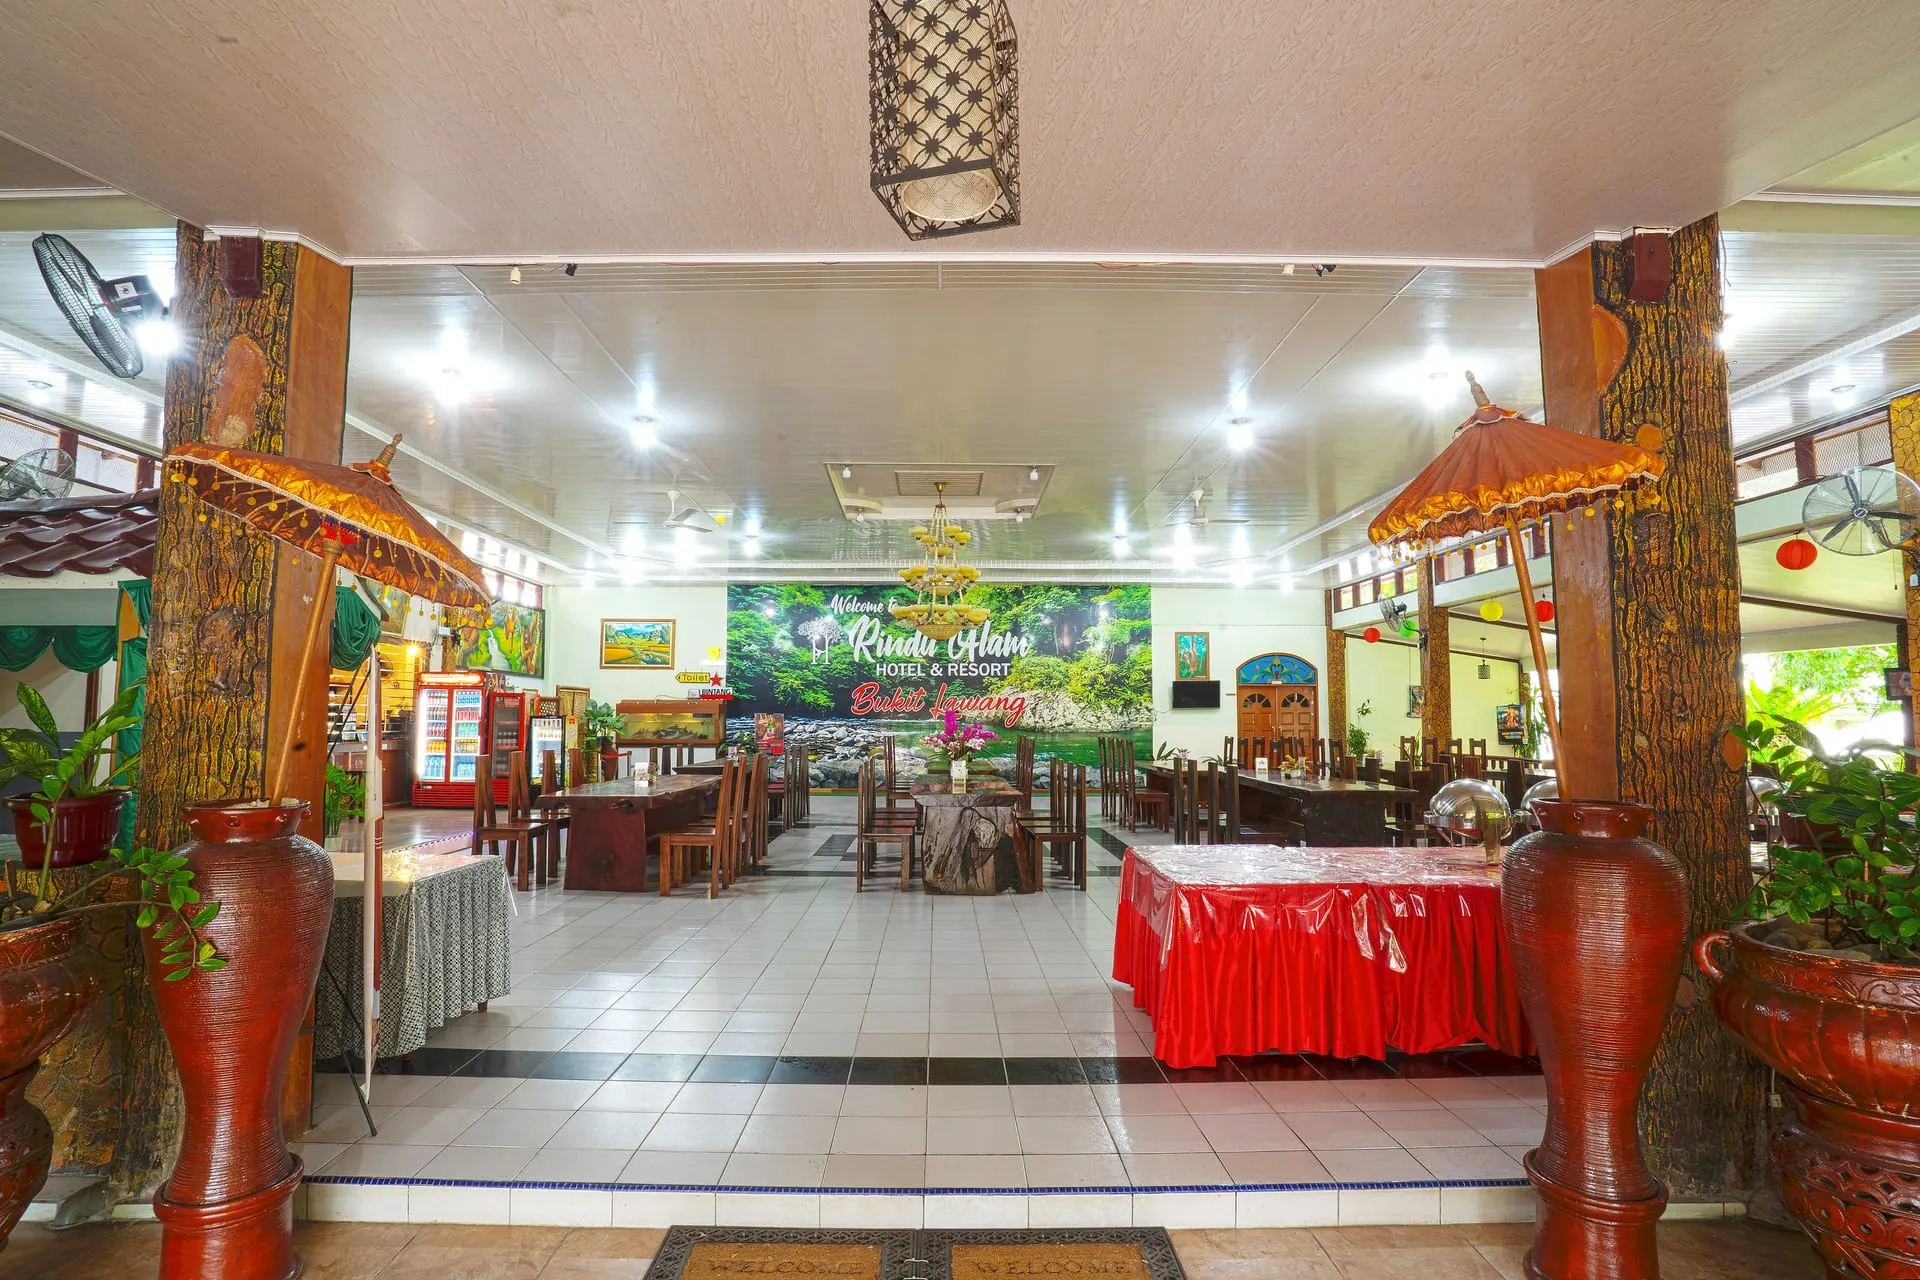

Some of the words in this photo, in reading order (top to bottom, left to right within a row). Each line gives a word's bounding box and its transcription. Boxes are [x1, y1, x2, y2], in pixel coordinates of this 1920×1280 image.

[831, 593, 885, 615] Welcome
[888, 597, 899, 613] to
[849, 614, 938, 663] Rindu
[948, 619, 1030, 662] Alam
[683, 674, 708, 682] Toilet
[876, 663, 926, 677] HOTEL
[930, 663, 944, 677] &
[947, 663, 1010, 677] RESORT
[701, 688, 731, 696] BINTANG
[851, 681, 927, 715] Bukit
[929, 683, 1029, 728] Lawang
[709, 1259, 862, 1275] WELCOME
[974, 1259, 1131, 1275] WELCOME
